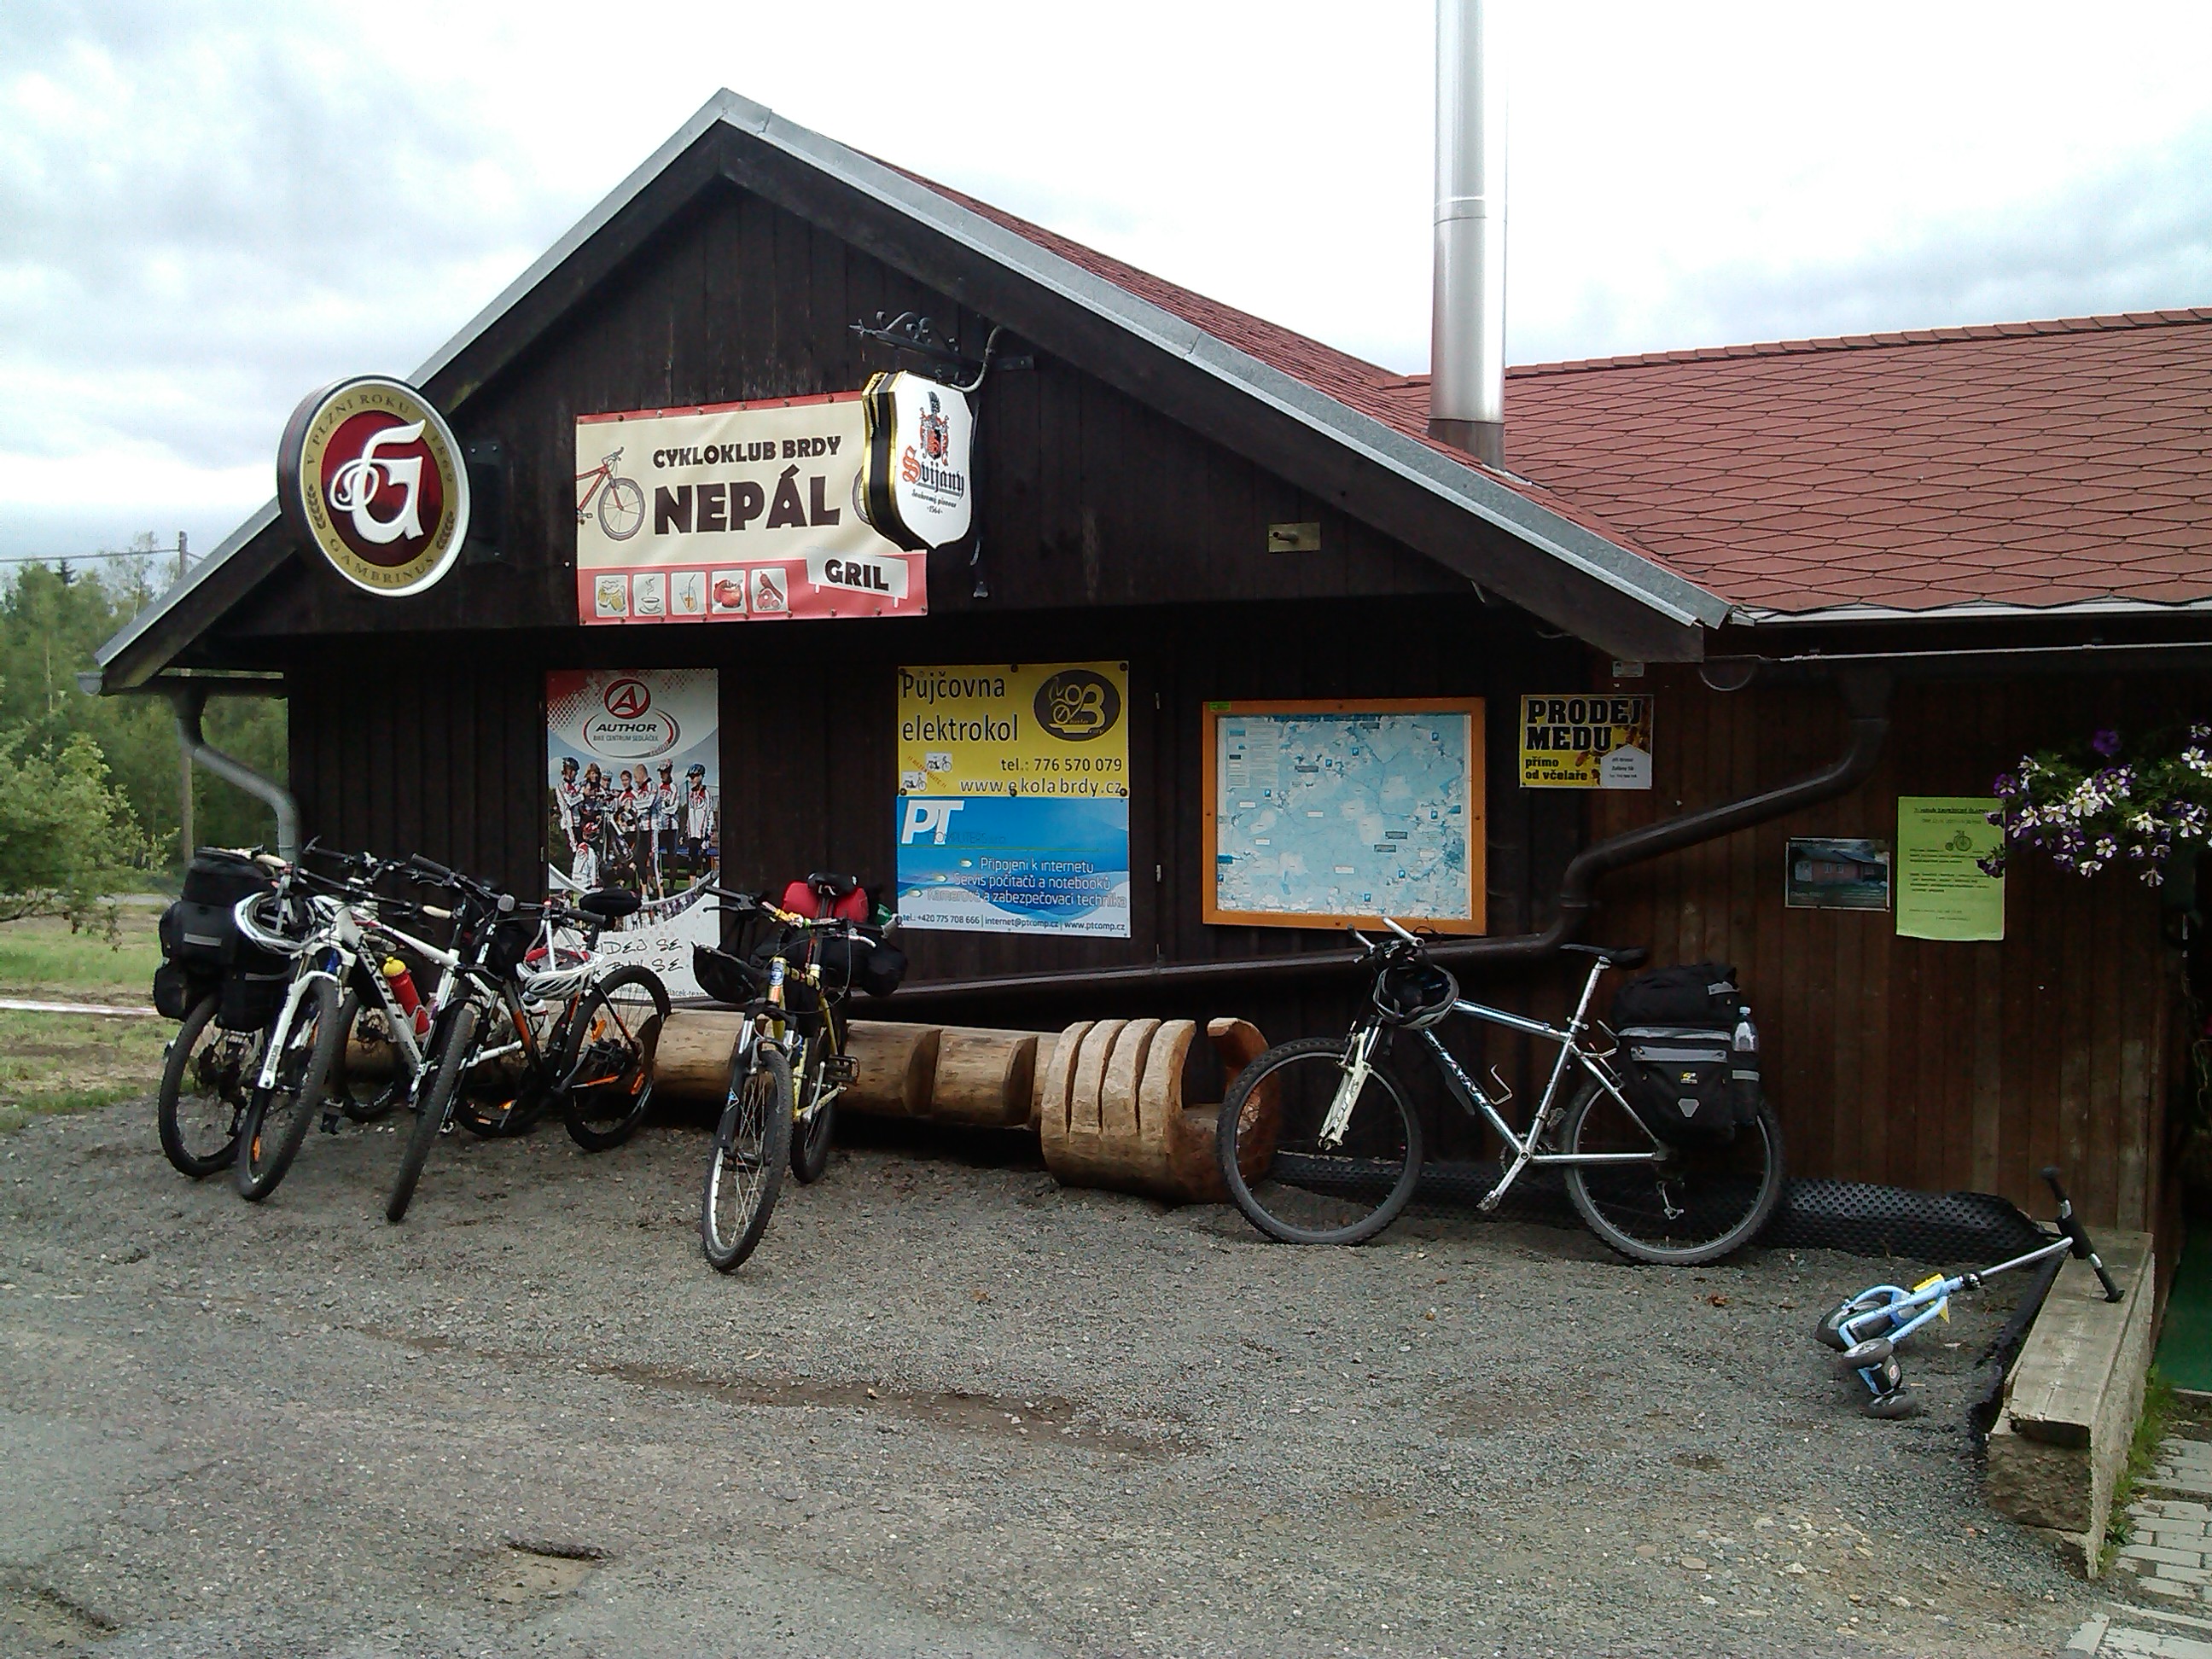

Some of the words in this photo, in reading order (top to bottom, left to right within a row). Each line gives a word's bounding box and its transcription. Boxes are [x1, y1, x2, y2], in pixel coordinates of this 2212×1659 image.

[312, 399, 354, 447] PLZNI
[359, 393, 410, 414] ROKU
[653, 441, 776, 469] CYKLOKLUB
[782, 435, 841, 460] BRDY
[902, 445, 965, 500] Svijany
[654, 463, 841, 535] NEPÁL
[329, 537, 434, 584] GAMBRINUS
[824, 558, 890, 591] GRIL
[902, 671, 1005, 705] Půjčovna
[1527, 699, 1642, 725] PRODEJ
[596, 724, 658, 732] AUTHOR
[902, 714, 1018, 741] elektrokol
[1526, 726, 1612, 751] MEDU
[1001, 758, 1029, 771] tel.:
[1034, 758, 1060, 771] 776
[1064, 758, 1091, 771] 570
[1095, 758, 1123, 771] 079
[1525, 755, 1559, 768] přímo
[1525, 770, 1540, 780] od
[1542, 769, 1588, 781] včelaře
[901, 800, 965, 845] PT
[1032, 858, 1038, 871] k
[1040, 861, 1094, 872] internetu
[952, 873, 987, 887] Servis
[1038, 879, 1045, 888] a
[1049, 876, 1111, 891] notebooků
[983, 893, 990, 901] a
[1077, 894, 1127, 908] technika
[917, 913, 935, 923] +420
[936, 914, 949, 923] 775
[950, 915, 963, 923] 708
[965, 916, 981, 924] 666
[1064, 921, 1126, 931] www.ptcomp.cz
[655, 938, 684, 952] SE
[652, 958, 684, 973] SE
